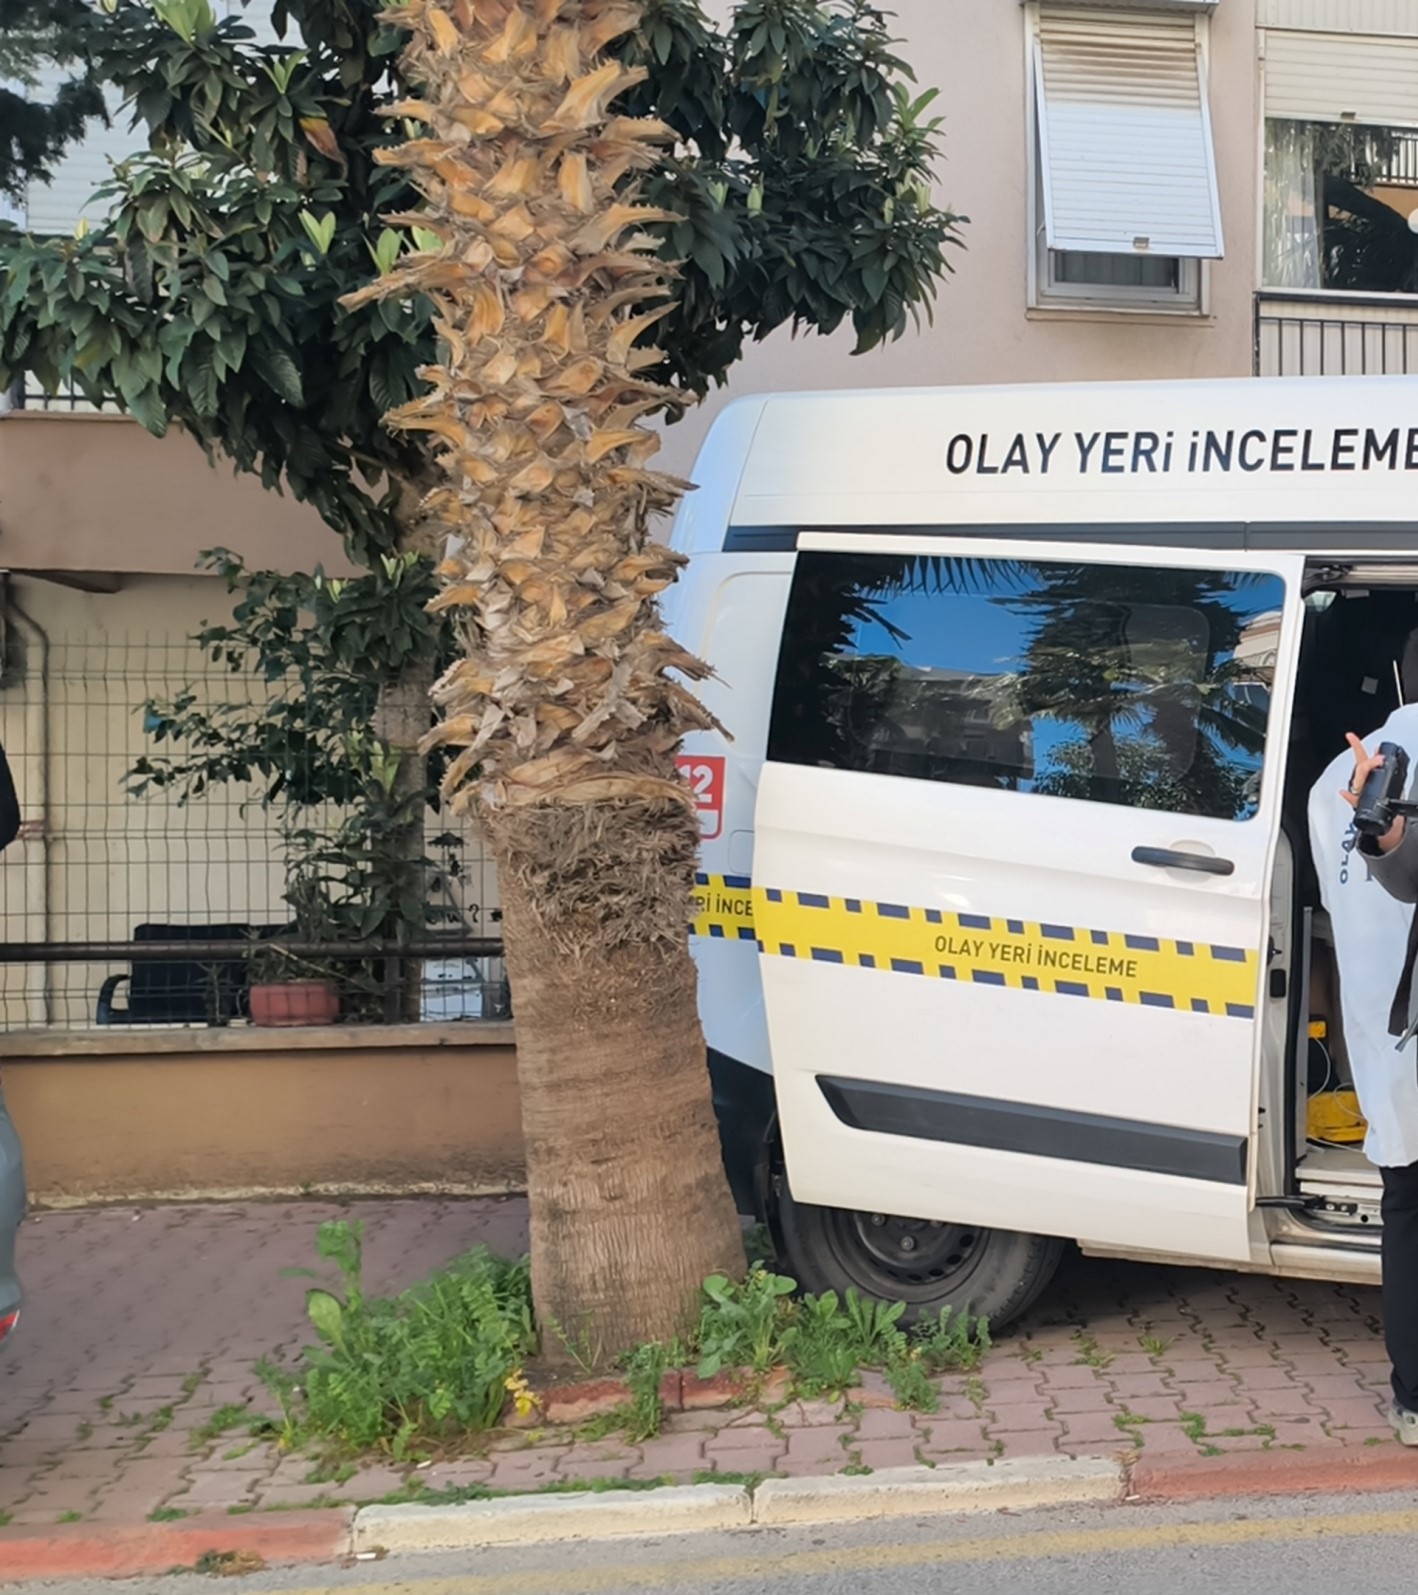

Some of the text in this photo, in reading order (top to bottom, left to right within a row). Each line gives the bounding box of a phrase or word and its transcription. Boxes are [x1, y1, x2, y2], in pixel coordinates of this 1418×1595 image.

[946, 432, 1063, 475] OLAY
[689, 892, 711, 912] Rİ
[934, 935, 1139, 978] OLAY YERİ İNCELEME
